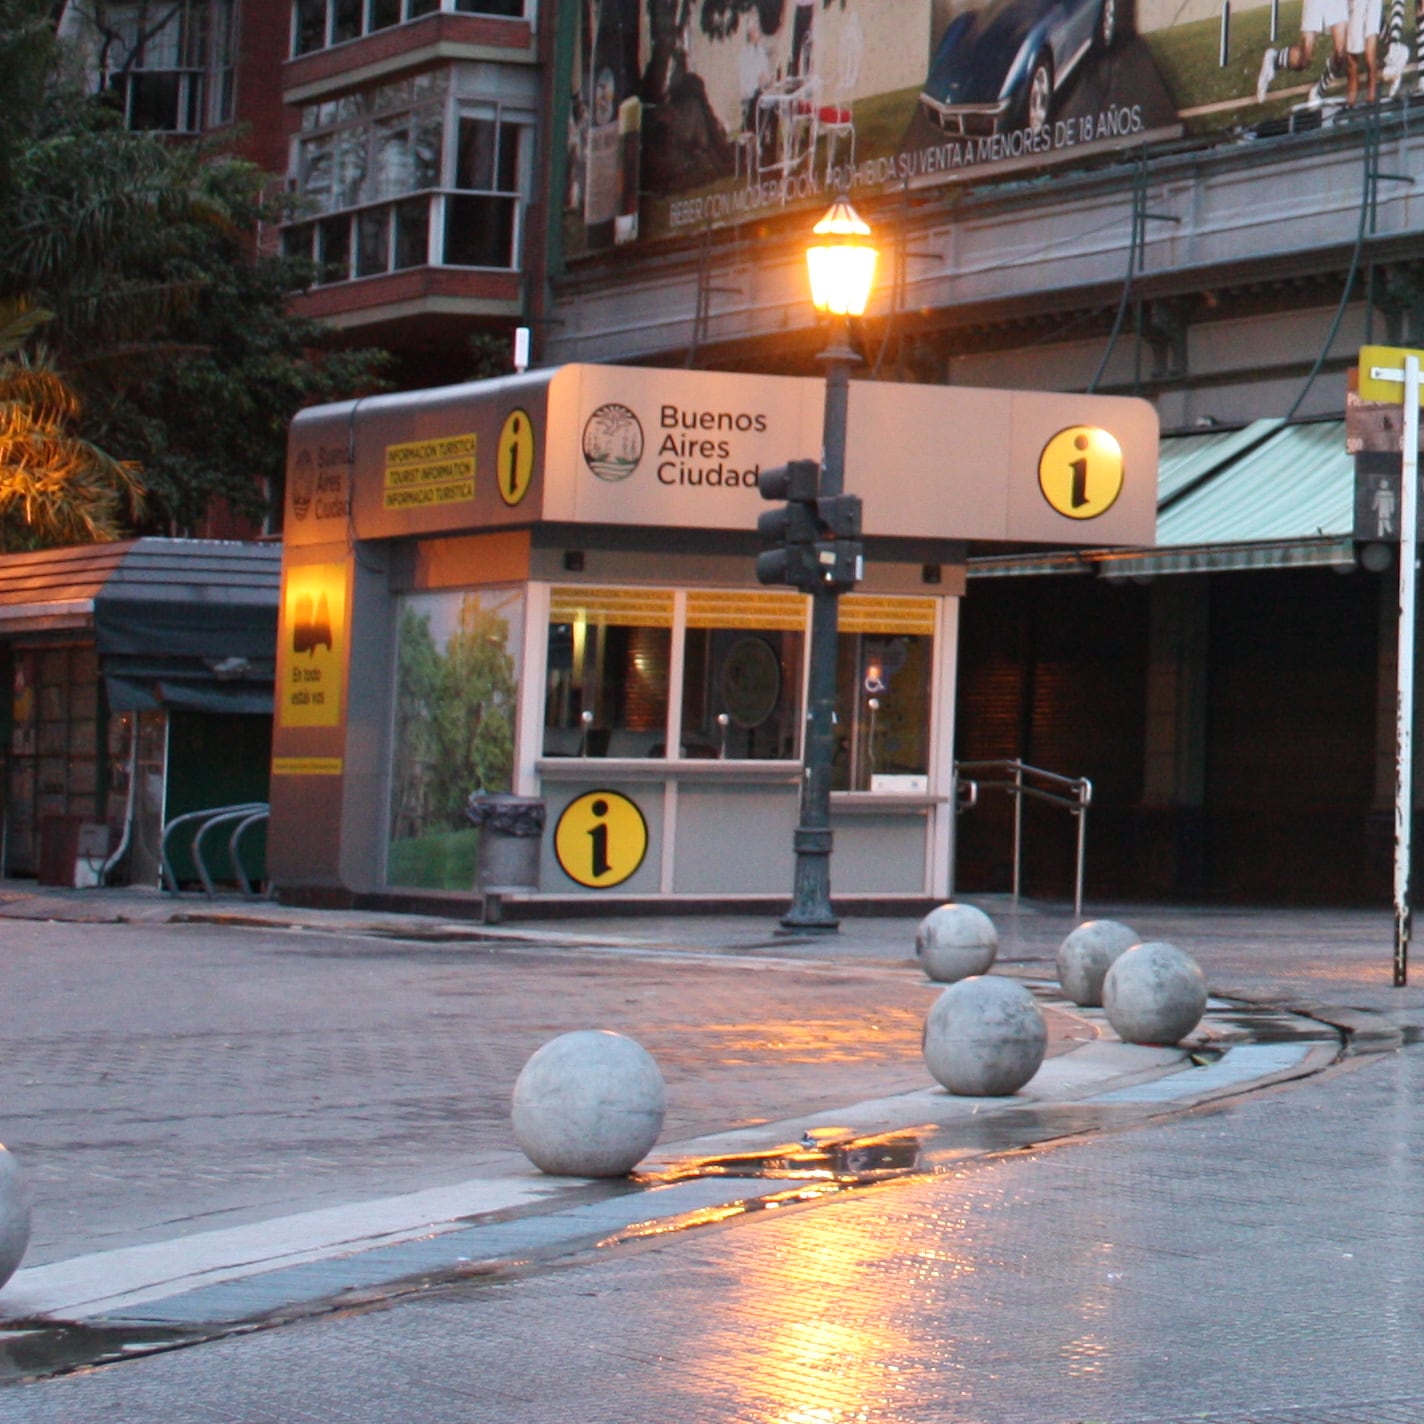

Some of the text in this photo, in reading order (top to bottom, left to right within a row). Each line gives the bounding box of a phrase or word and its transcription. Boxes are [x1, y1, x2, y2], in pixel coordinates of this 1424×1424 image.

[900, 152, 917, 179] SU
[920, 142, 963, 174] VENTA
[963, 141, 975, 166] A
[976, 123, 1051, 162] MENORES
[1054, 117, 1075, 149] DE
[1079, 113, 1094, 144] 18
[1096, 104, 1145, 136] AÑOS.
[660, 404, 767, 433] Buenos
[658, 433, 730, 459] Aires
[657, 460, 760, 488] Ciudad
